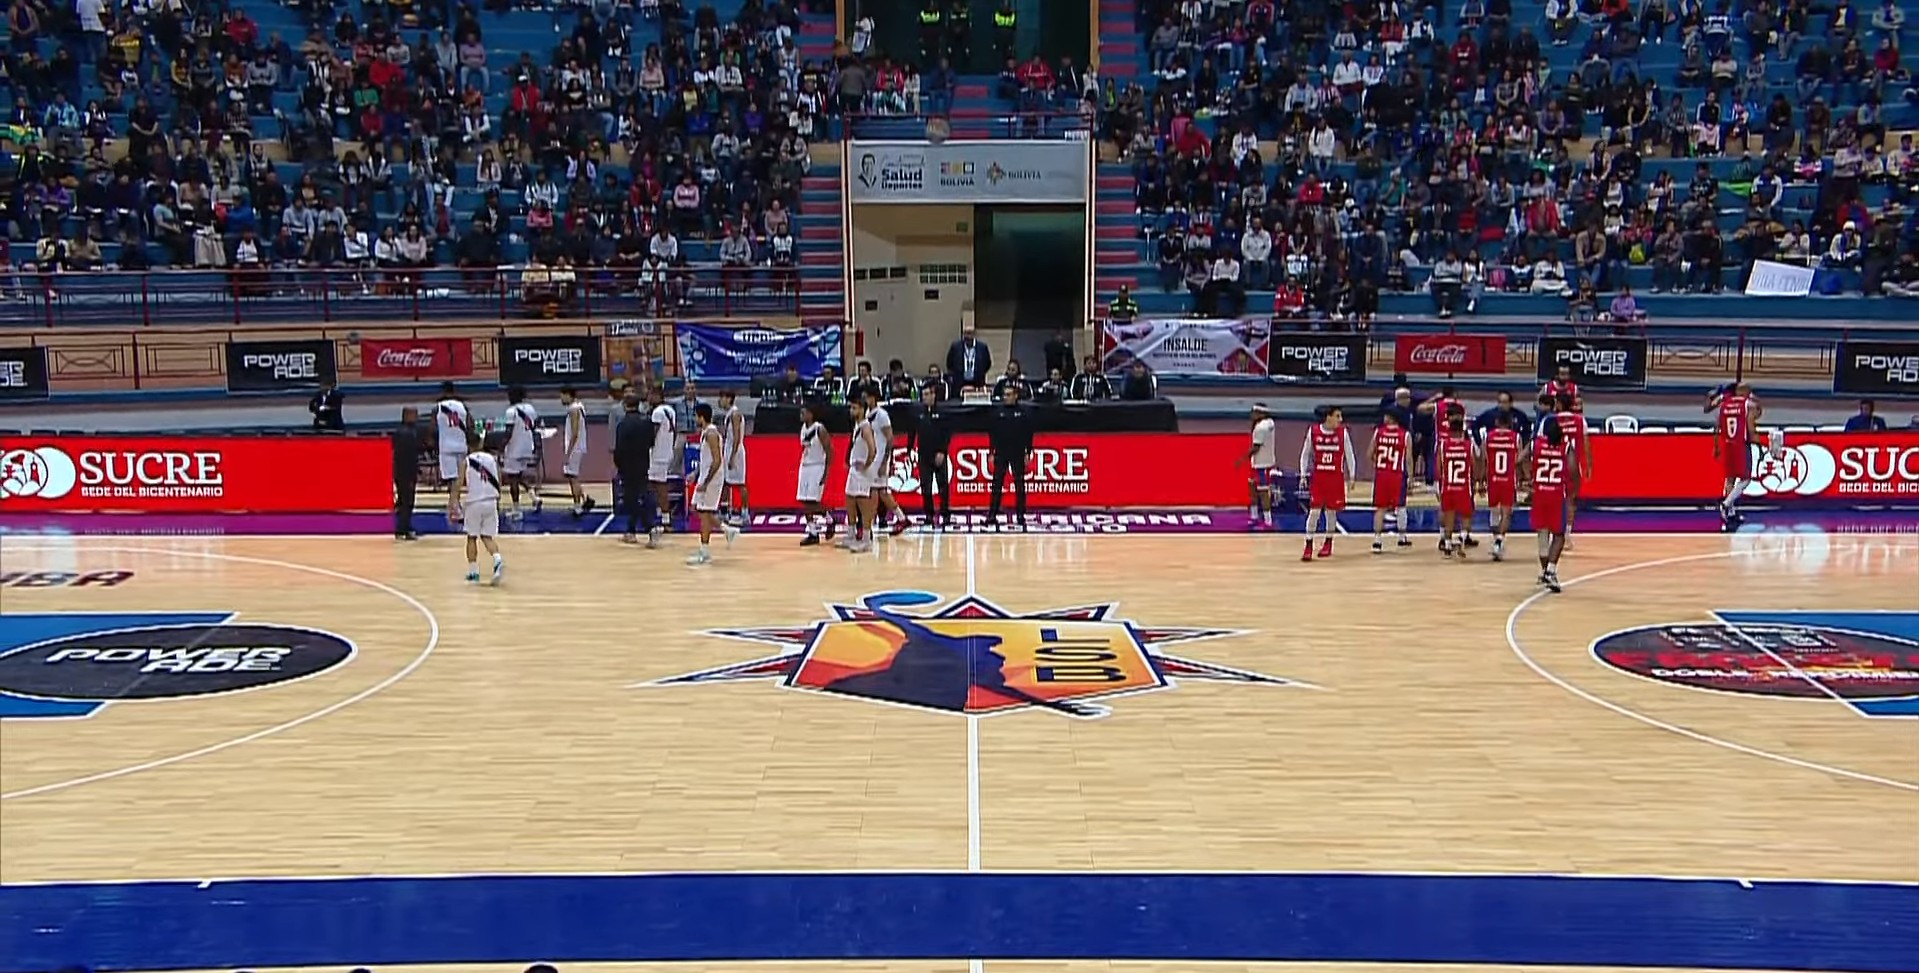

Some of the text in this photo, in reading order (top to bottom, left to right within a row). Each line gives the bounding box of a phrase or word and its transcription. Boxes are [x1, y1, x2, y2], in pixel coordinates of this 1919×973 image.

[881, 168, 923, 182] Salud
[881, 181, 923, 191] Deportes
[941, 178, 974, 187] BOLIVIA
[515, 349, 582, 362] POWER
[1281, 346, 1349, 360] POWER
[1555, 350, 1627, 363] POWER
[243, 353, 316, 368] POWER
[543, 360, 583, 373] ADE
[1308, 358, 1348, 371] ADE
[1855, 355, 1919, 369] POWE
[274, 366, 317, 379] ADE
[1583, 361, 1626, 375] ADE
[1321, 453, 1333, 464] 20
[1377, 446, 1399, 471] 24
[1495, 451, 1507, 474] 0
[1839, 447, 1919, 480] SUC
[79, 451, 223, 485] SUCRE
[1448, 460, 1466, 484] 12
[1536, 458, 1563, 483] 22
[81, 486, 223, 497] SEDE DEL BICENTENARIO
[957, 482, 984, 493] SEDE
[1839, 482, 1919, 493] SEDE DEL BIC
[46, 647, 292, 663] POWER
[140, 658, 282, 673] ADE
